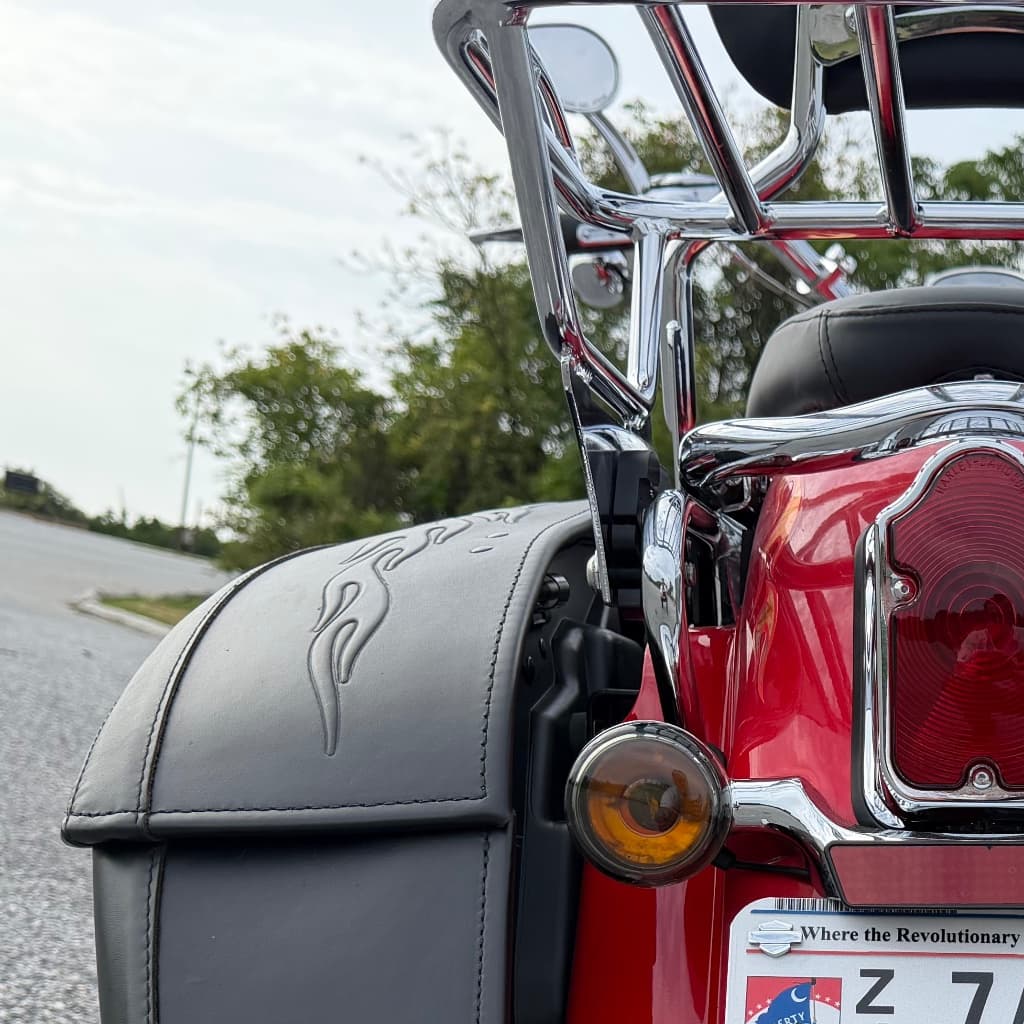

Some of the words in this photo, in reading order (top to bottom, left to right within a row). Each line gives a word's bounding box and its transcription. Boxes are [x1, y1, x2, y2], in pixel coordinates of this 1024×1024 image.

[800, 926, 859, 942] Where
[865, 926, 891, 943] the
[897, 927, 1021, 949] Revolutionary
